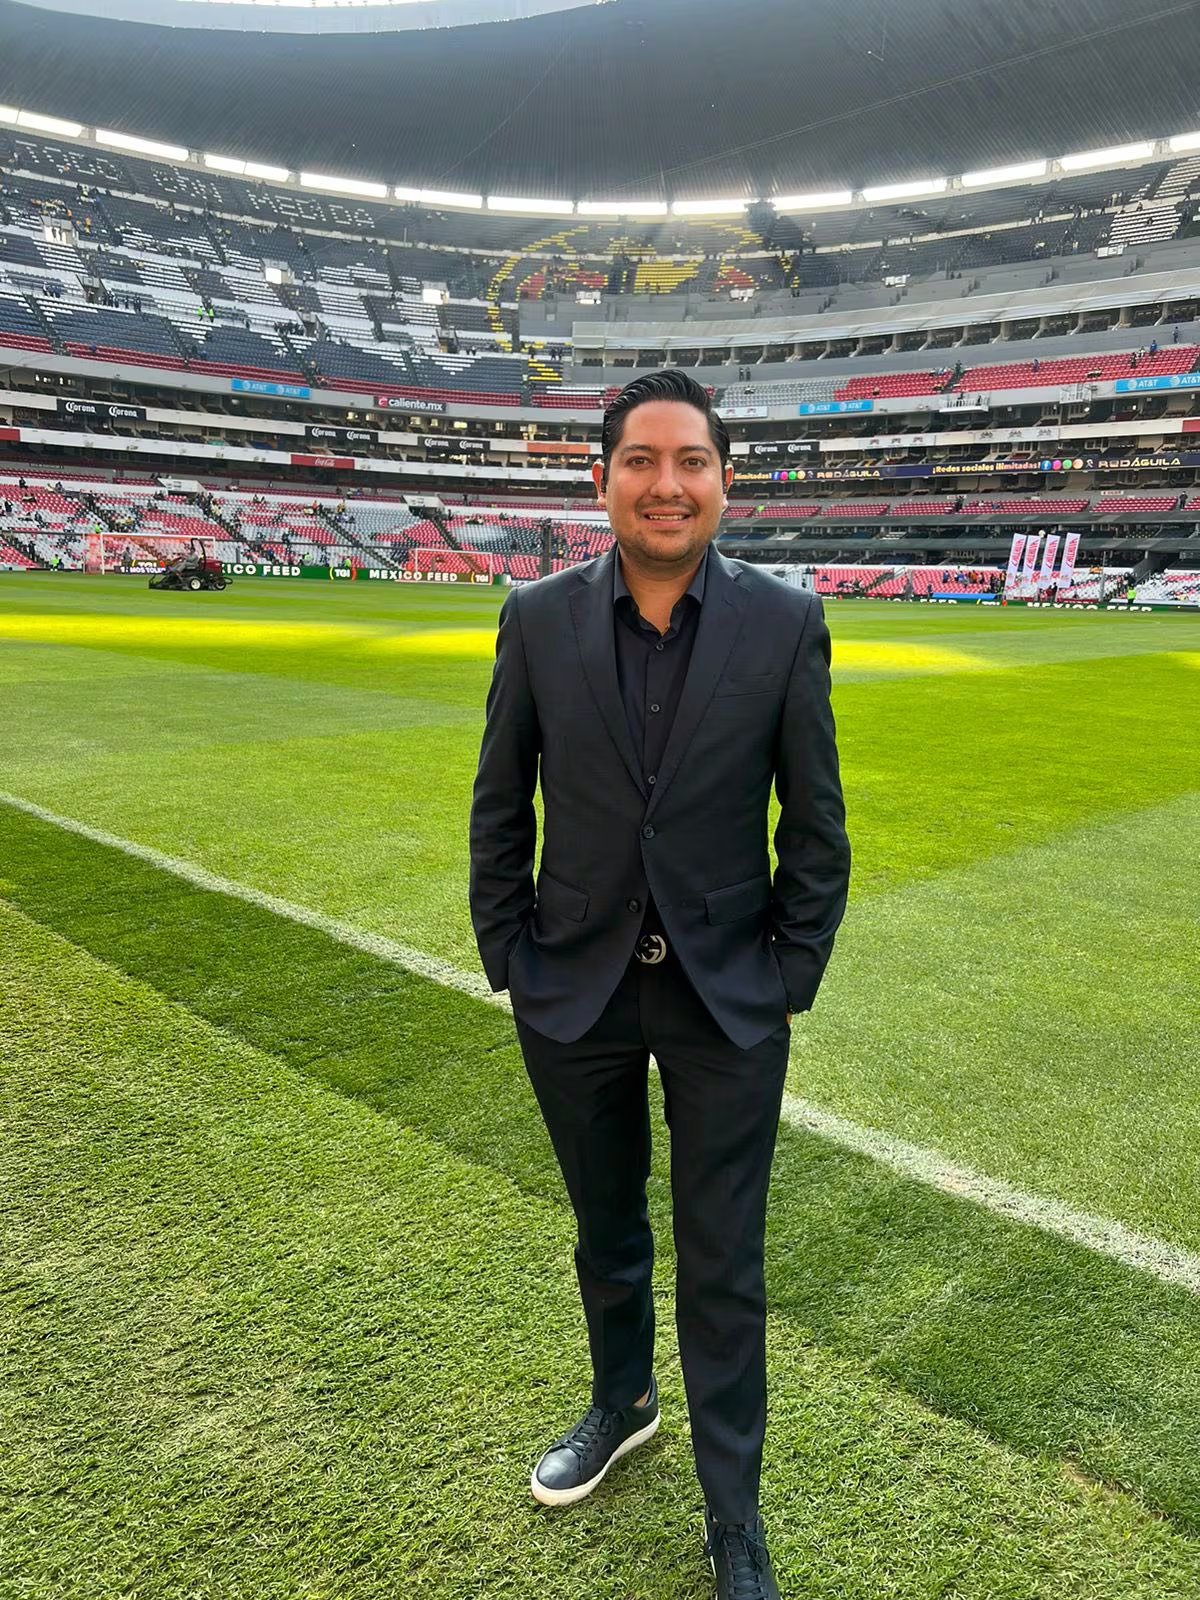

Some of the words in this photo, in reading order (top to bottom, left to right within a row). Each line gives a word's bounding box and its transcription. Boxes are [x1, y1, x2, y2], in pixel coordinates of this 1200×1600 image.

[1137, 379, 1159, 388] AT&T
[65, 401, 97, 414] Corona
[388, 397, 444, 411] caliente.mx
[108, 405, 139, 418] Corona
[311, 427, 337, 438] Corona
[346, 431, 371, 441] Corona
[424, 438, 449, 447] Corona
[459, 440, 484, 450] Corona
[787, 443, 812, 453] Corona
[754, 444, 778, 454] Corona
[961, 463, 995, 472] sociales
[995, 461, 1041, 471] ilimitadas!
[221, 564, 257, 575] ICO
[263, 565, 301, 577] FEED
[369, 569, 422, 580] MEXICO
[427, 572, 458, 582] FEED
